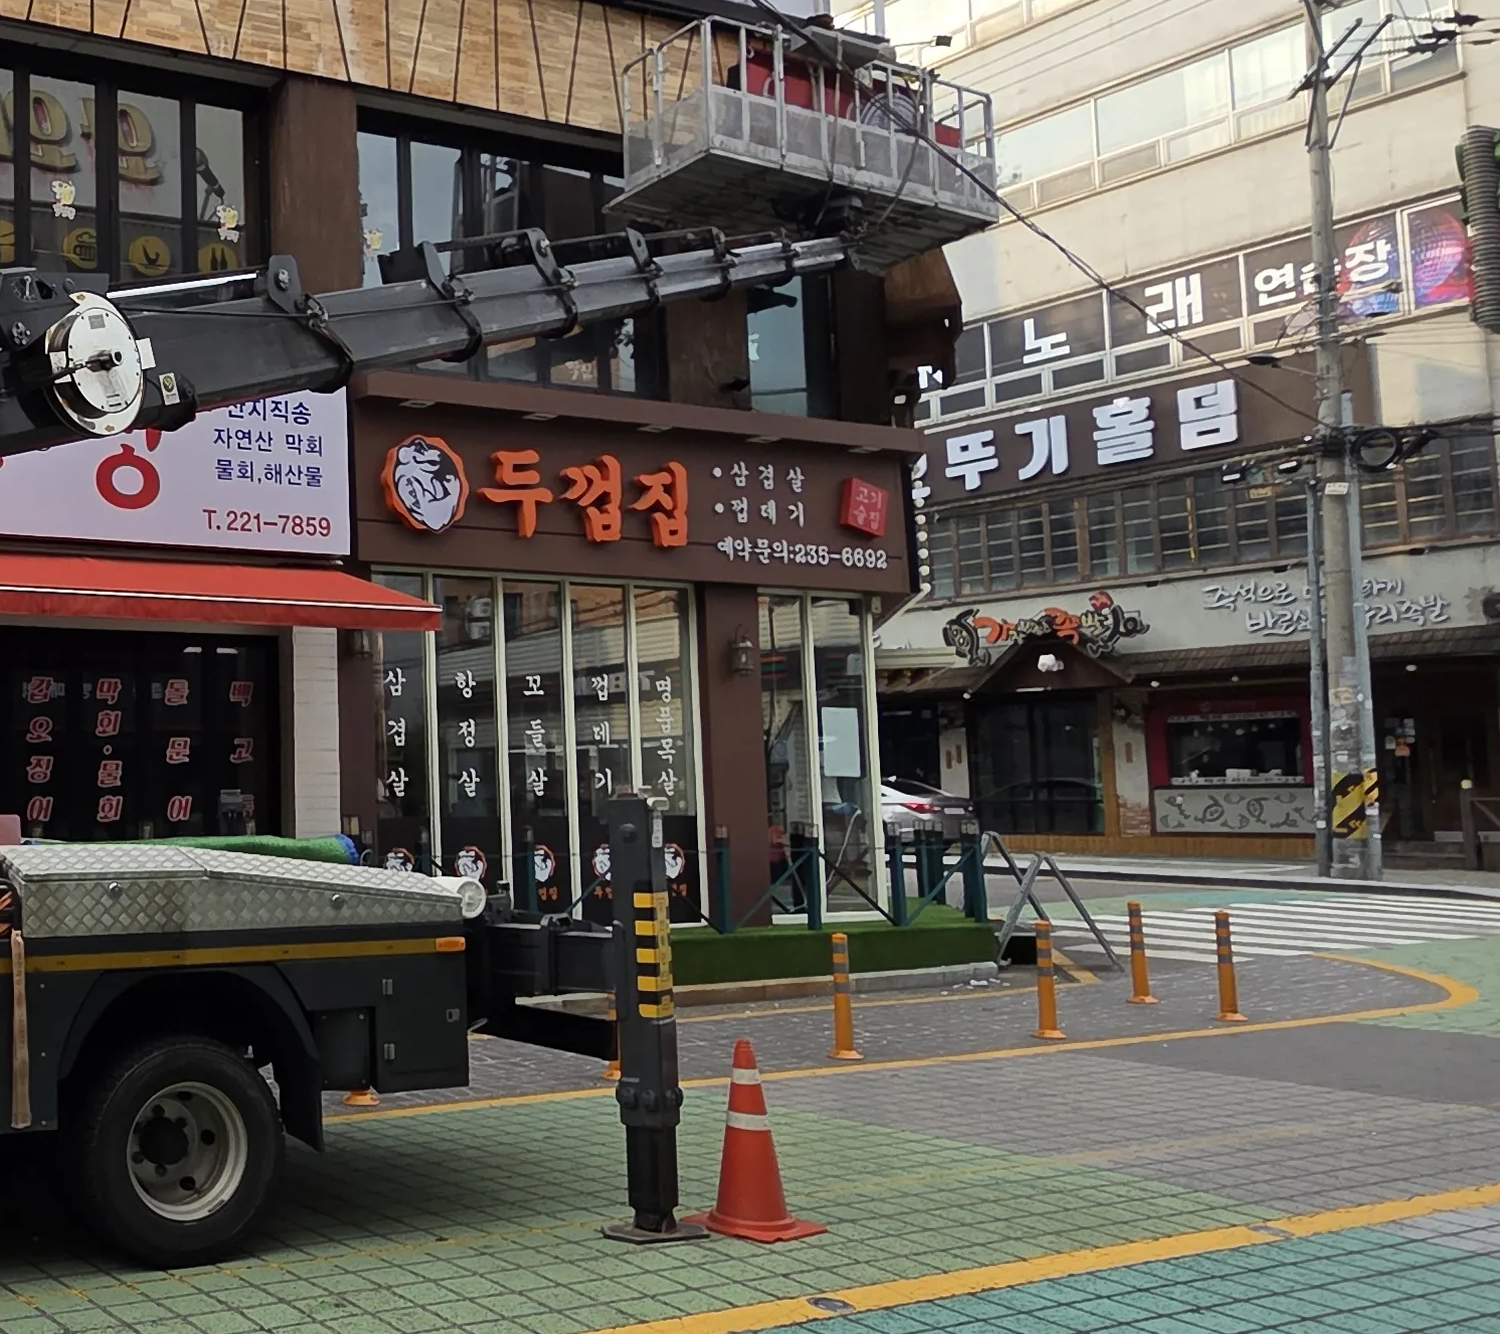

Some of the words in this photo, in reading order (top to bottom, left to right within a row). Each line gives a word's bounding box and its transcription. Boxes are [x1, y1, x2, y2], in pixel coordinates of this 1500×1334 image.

[212, 427, 273, 454] 자연산
[284, 433, 324, 458] 막회
[475, 448, 689, 548] 두껍집
[454, 669, 482, 798] 항정살
[521, 674, 549, 797] 꼬들살
